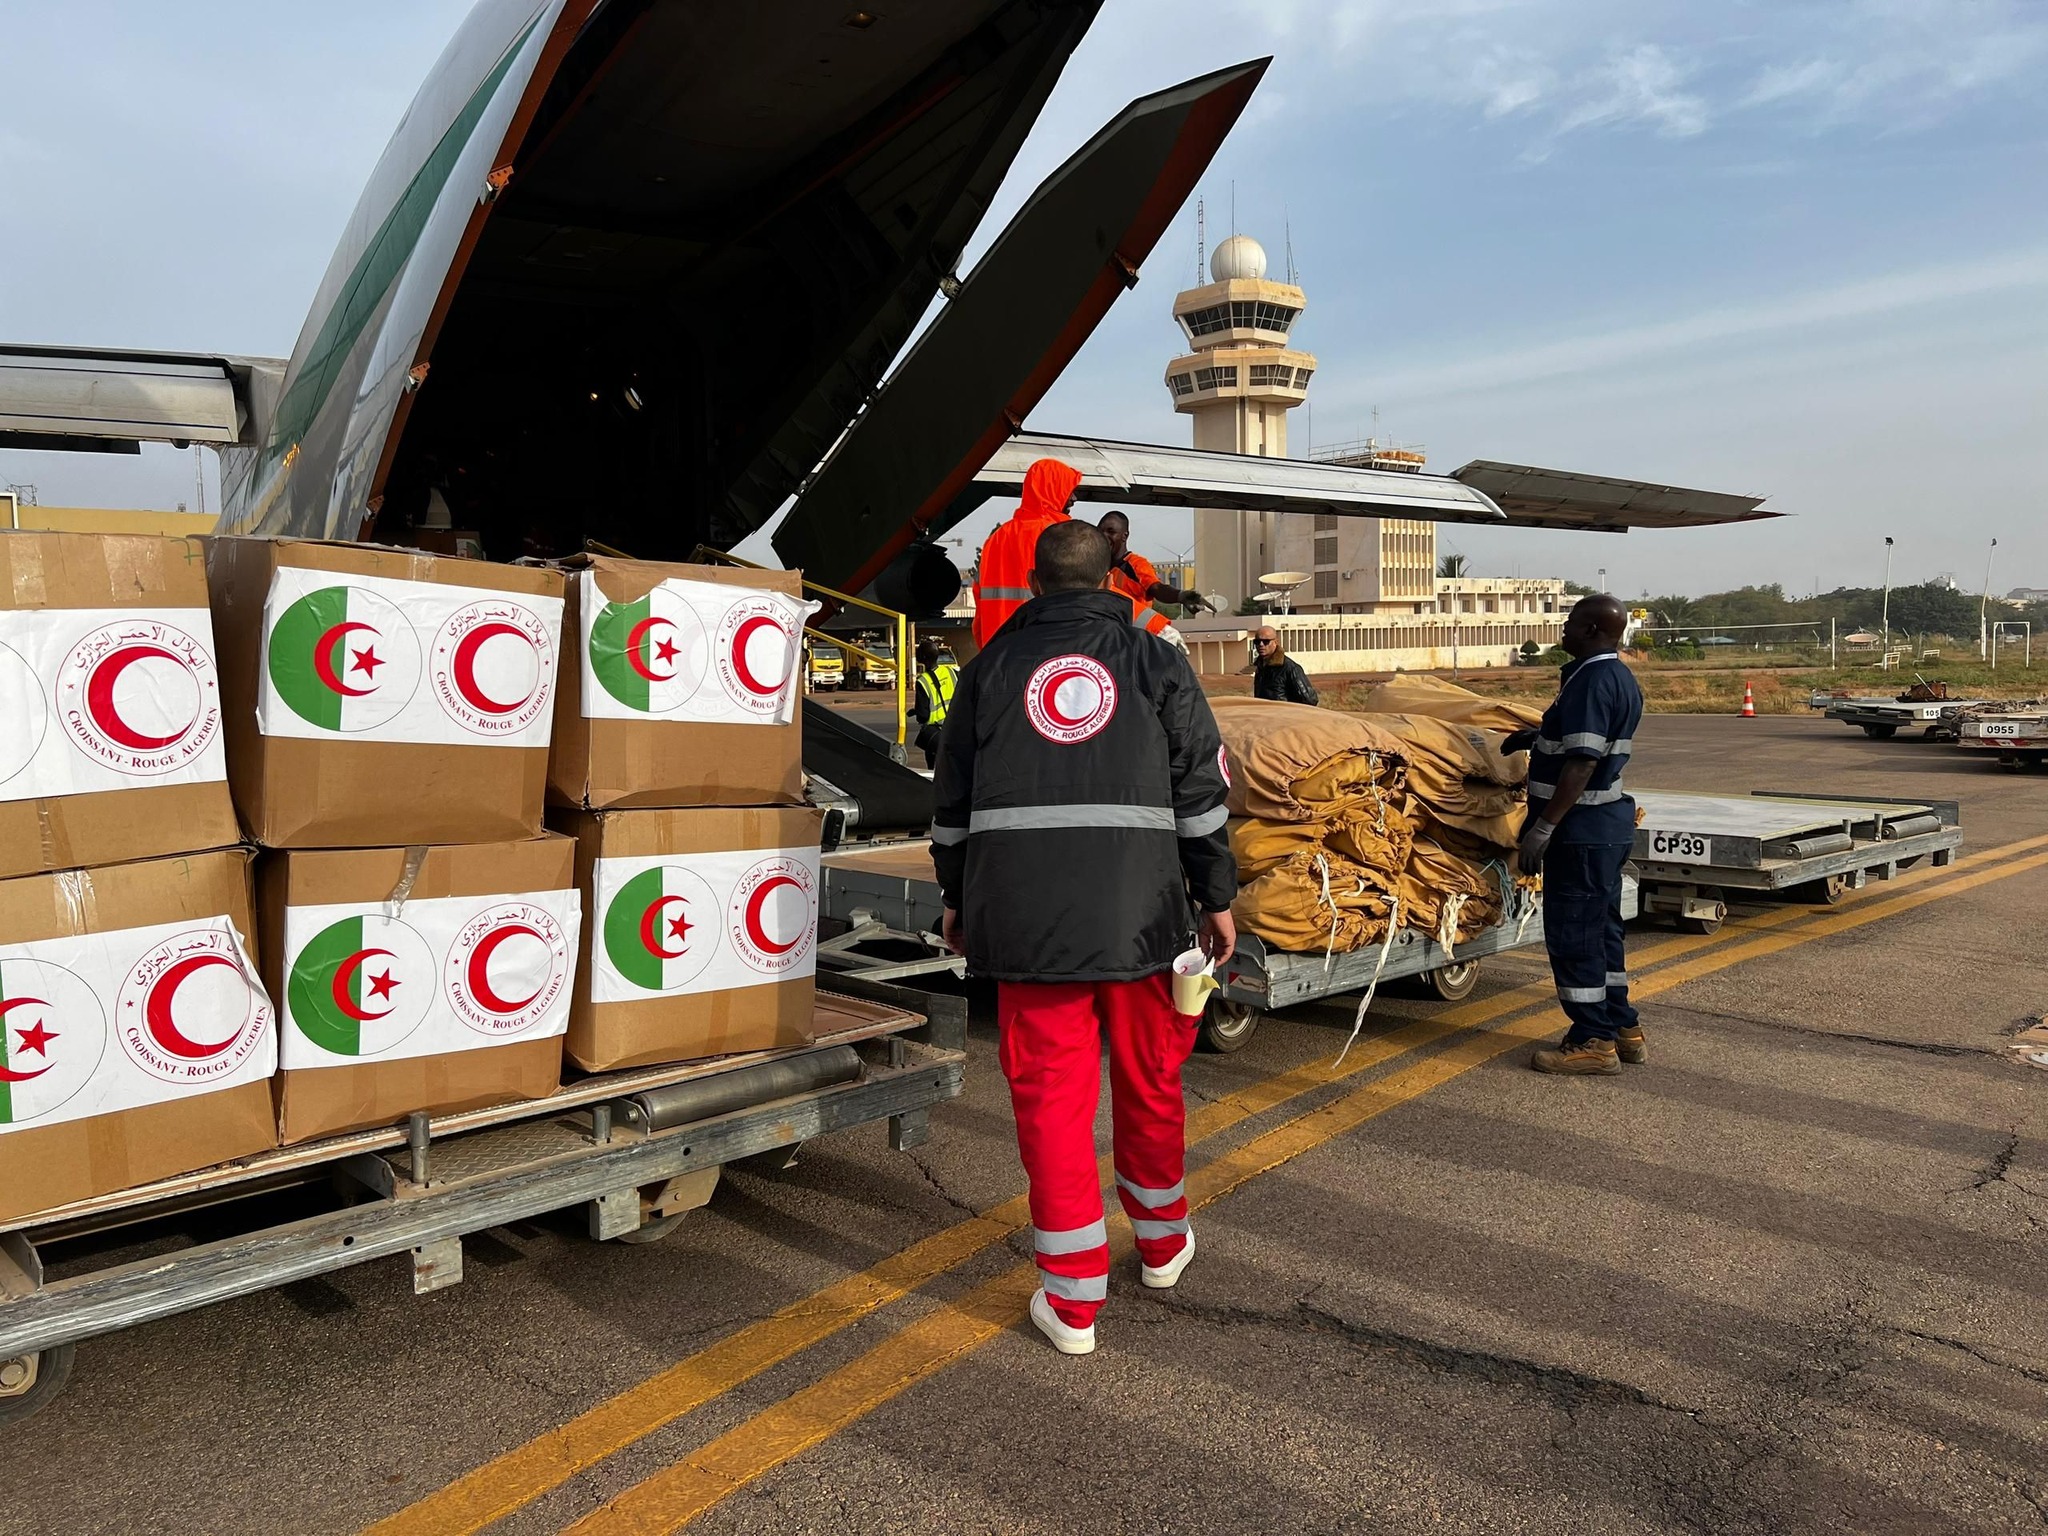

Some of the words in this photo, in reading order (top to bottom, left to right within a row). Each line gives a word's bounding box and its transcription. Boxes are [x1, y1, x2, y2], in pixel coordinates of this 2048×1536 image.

[519, 683, 548, 724] ALGERIEN
[1090, 696, 1112, 730] ALGERIEN
[181, 707, 217, 758] ALGERIEN
[1987, 726, 2014, 734] 0955
[1653, 836, 1704, 856] CP39
[795, 920, 816, 959] ALGERIEN
[531, 973, 562, 1018] ALGERIEN
[235, 1006, 266, 1061] ALGERIEN
